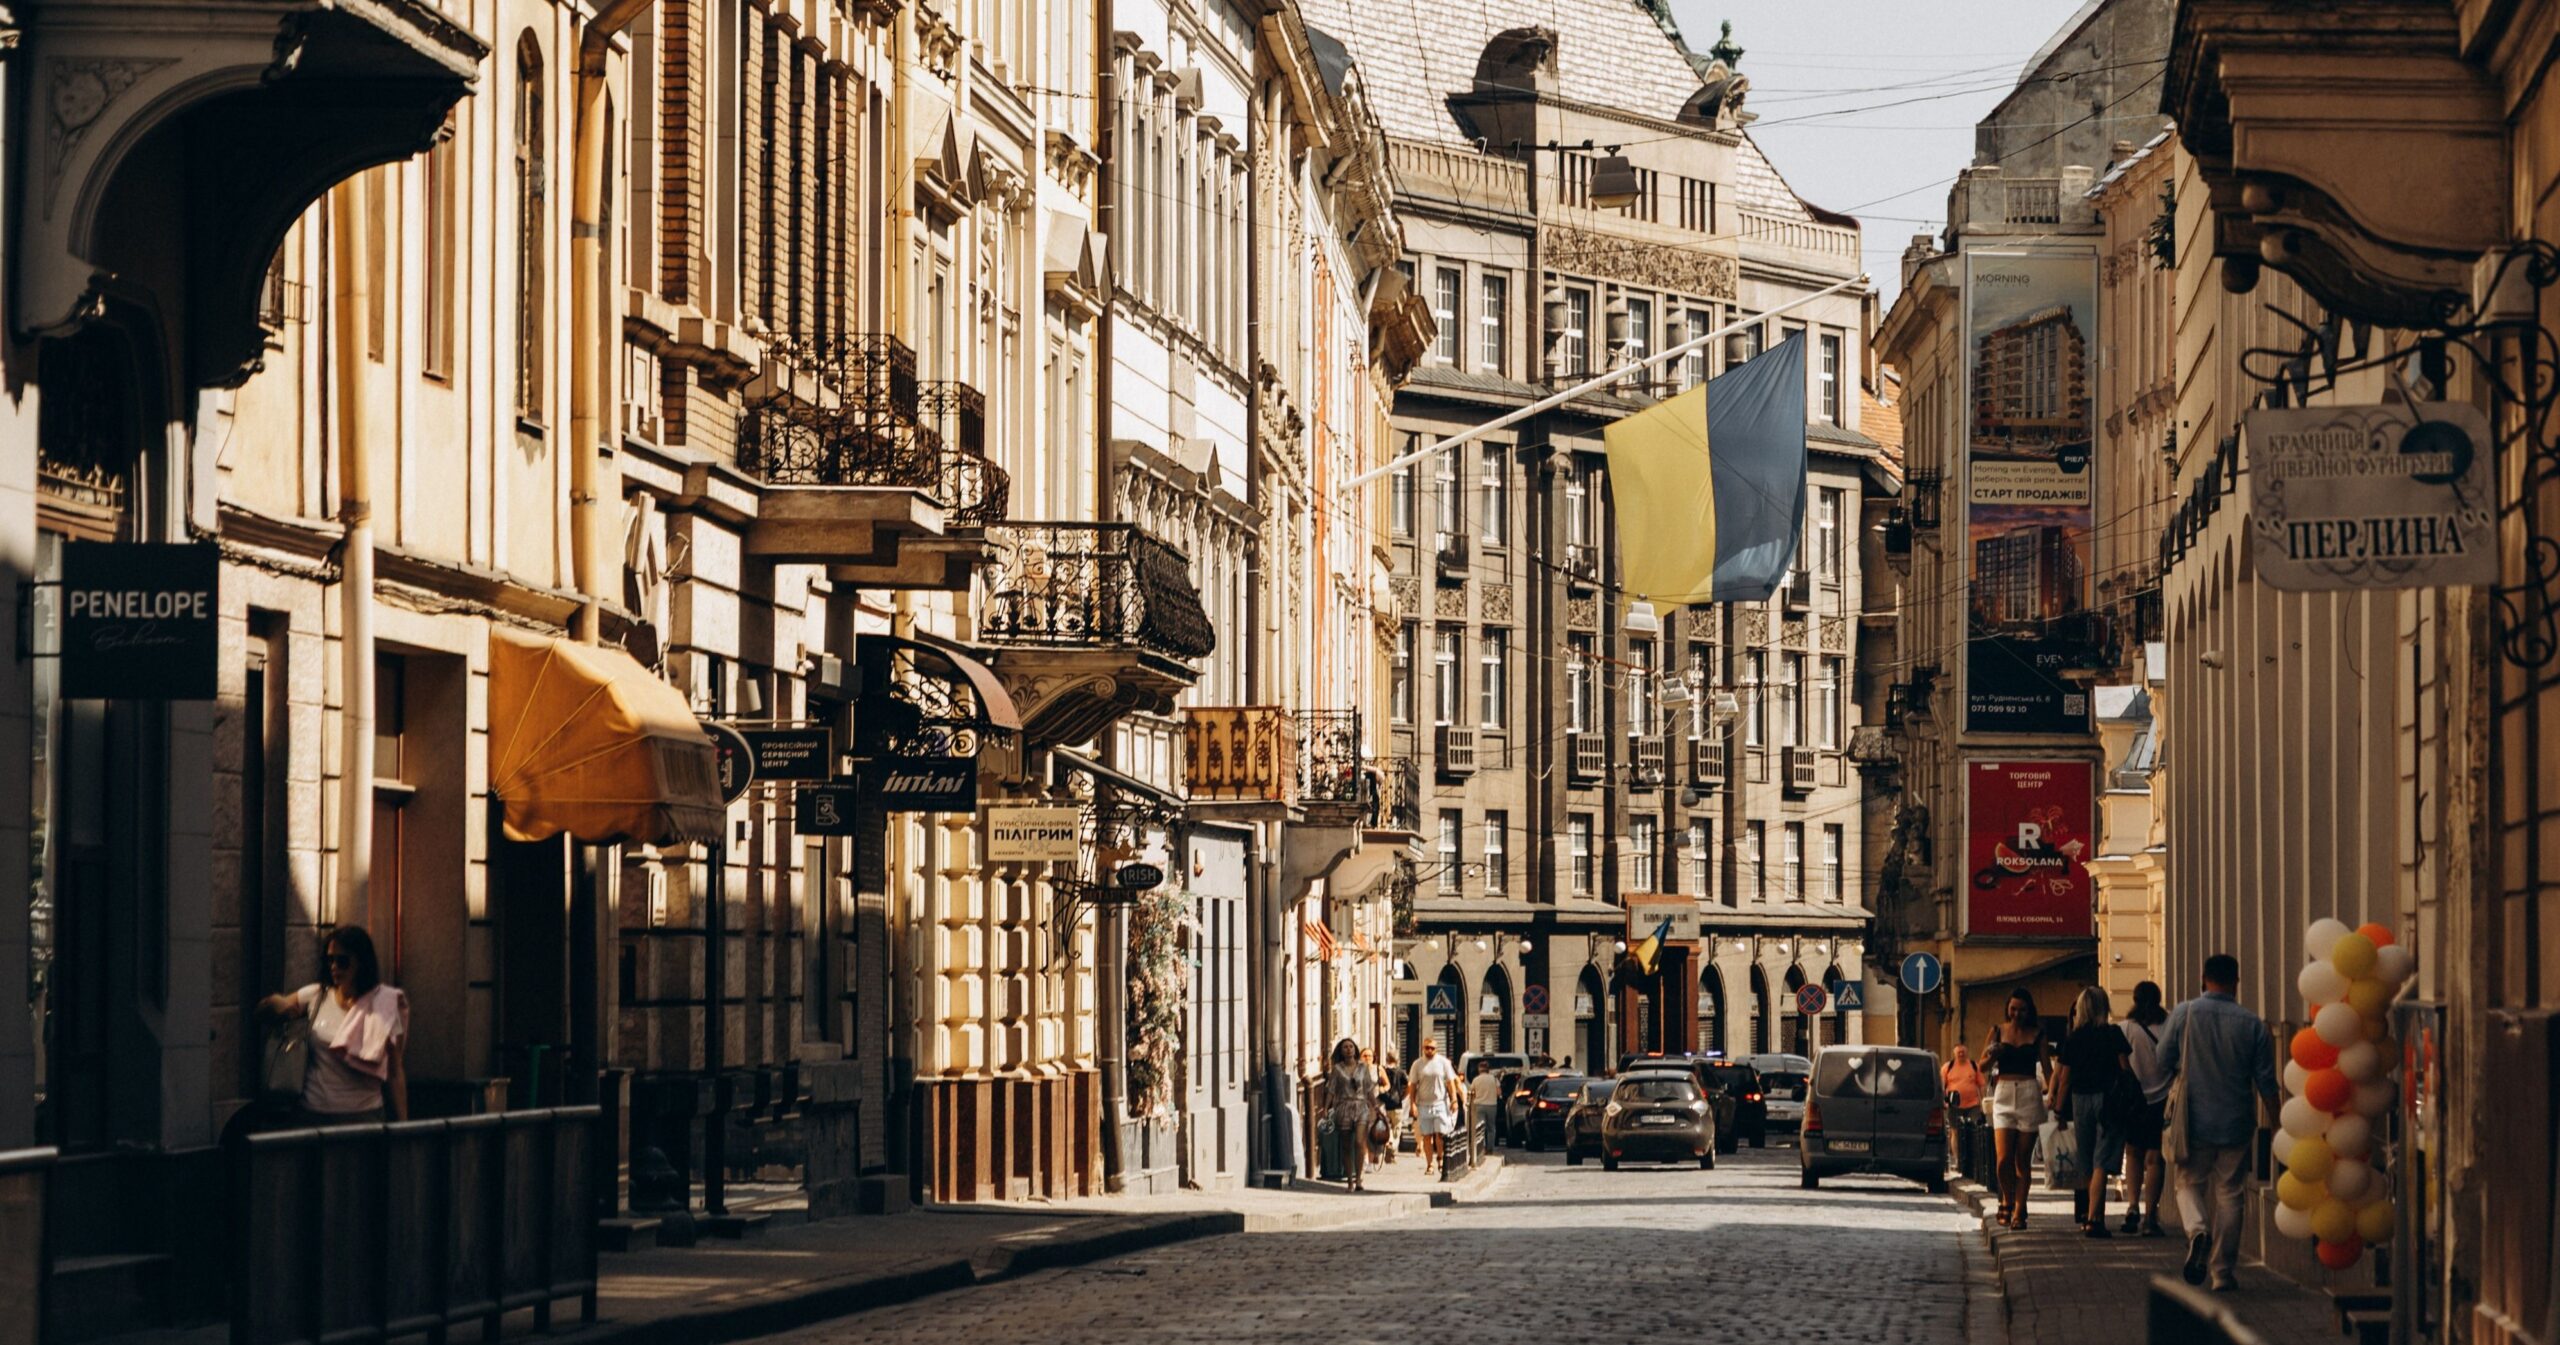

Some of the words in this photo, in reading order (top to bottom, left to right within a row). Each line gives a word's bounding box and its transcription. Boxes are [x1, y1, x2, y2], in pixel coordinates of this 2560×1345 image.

[1976, 274, 2031, 284] MORNING
[2268, 433, 2365, 455] КРАМНИЦЯ
[1974, 465, 2009, 474] Morning
[2023, 466, 2057, 475] Evening
[1974, 488, 2013, 499] СТАРТ
[2016, 490, 2087, 501] ПРОДАЖІВ!
[70, 589, 208, 619] PENELOPE
[1971, 704, 1986, 713] 073
[1988, 704, 2004, 713] 099
[2006, 705, 2016, 713] 92
[2018, 705, 2027, 713] 10
[762, 741, 818, 750] ПРОФЕСІЙНИЙ
[762, 760, 789, 768] ЦЕНТР
[2009, 772, 2051, 780] ТОРГОВИЙ
[2017, 781, 2043, 789] ЦЕНТР
[994, 829, 1073, 840] ПІЛІГРИМ
[2018, 822, 2041, 850] R
[1996, 857, 2063, 866] ROKSOLANA
[1123, 868, 1157, 881] IRISH
